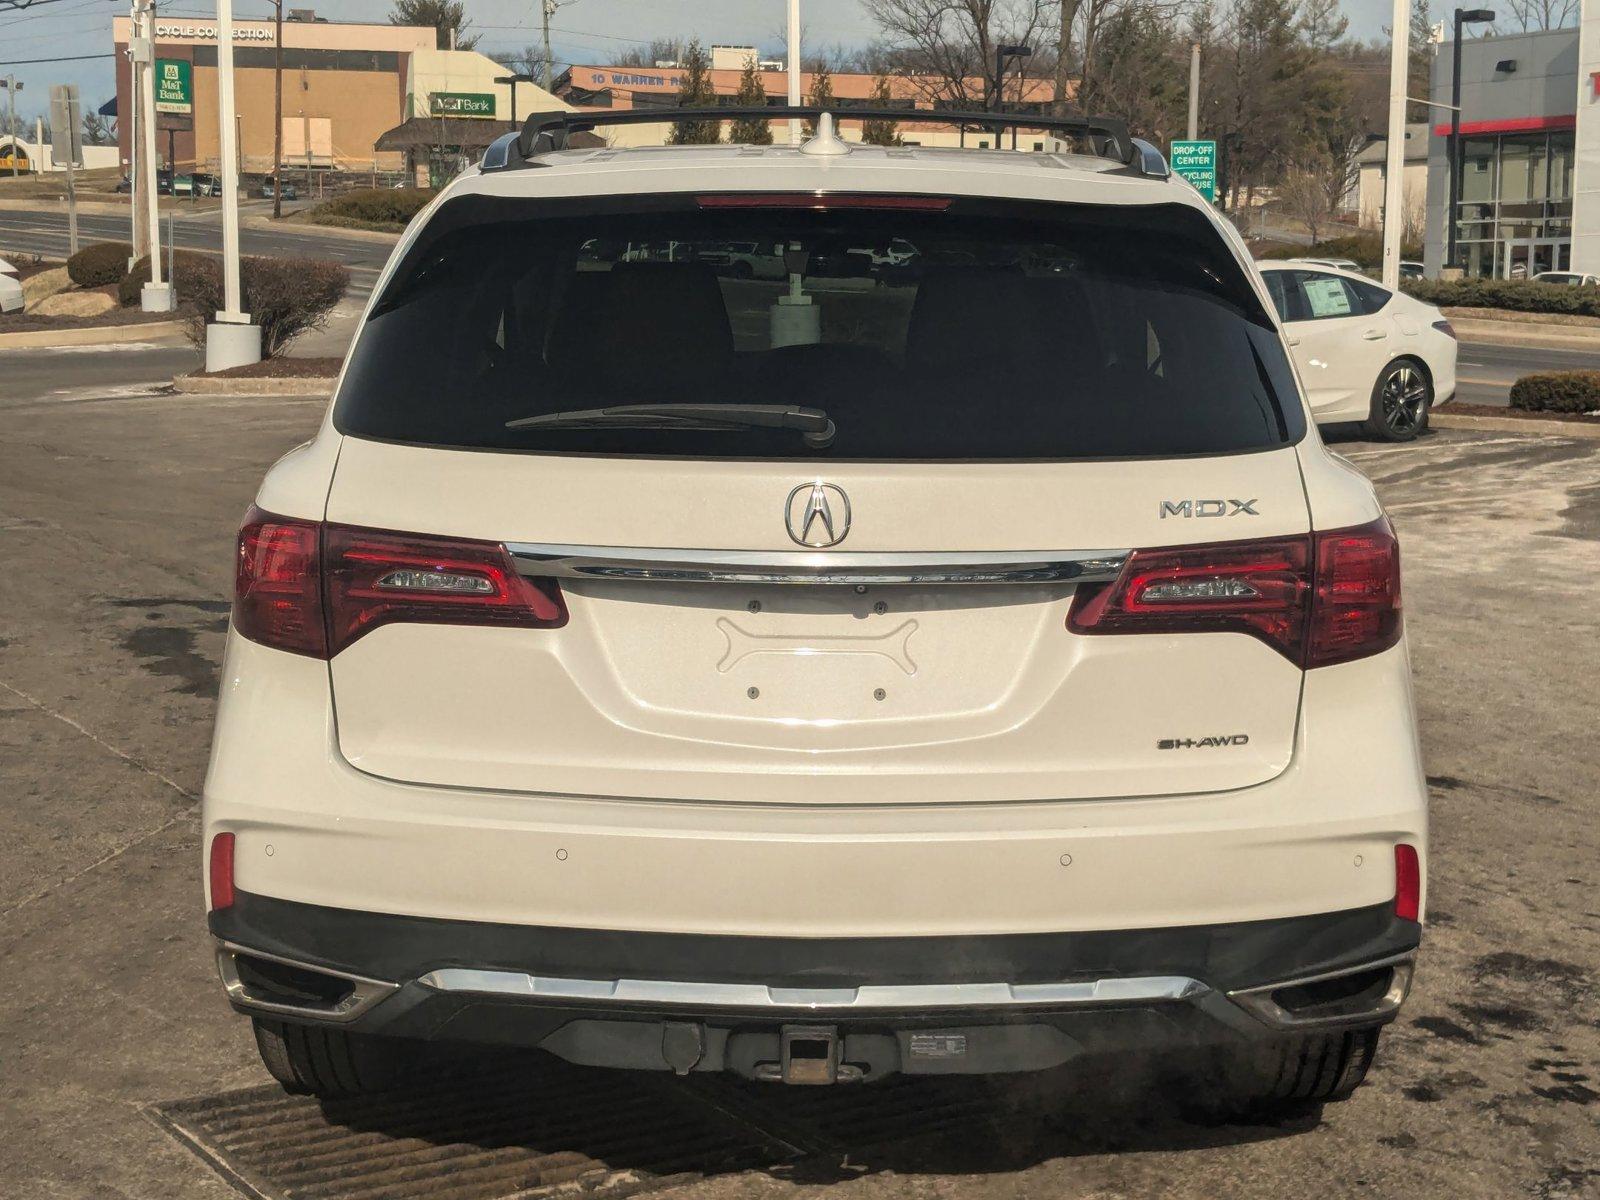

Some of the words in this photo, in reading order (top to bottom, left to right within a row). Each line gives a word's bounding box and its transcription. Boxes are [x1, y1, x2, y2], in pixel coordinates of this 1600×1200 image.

[155, 25, 194, 37] CYCLE
[198, 27, 273, 39] COECTION
[592, 73, 605, 84] 10
[612, 74, 664, 86] WARREN
[160, 90, 184, 100] Bank
[464, 99, 489, 111] Bank
[1173, 146, 1213, 155] DROP-OFF
[1176, 156, 1210, 165] CENTER
[1182, 171, 1213, 180] CYCLING
[1159, 498, 1260, 519] MDX
[1156, 734, 1249, 750] SH-AWD
